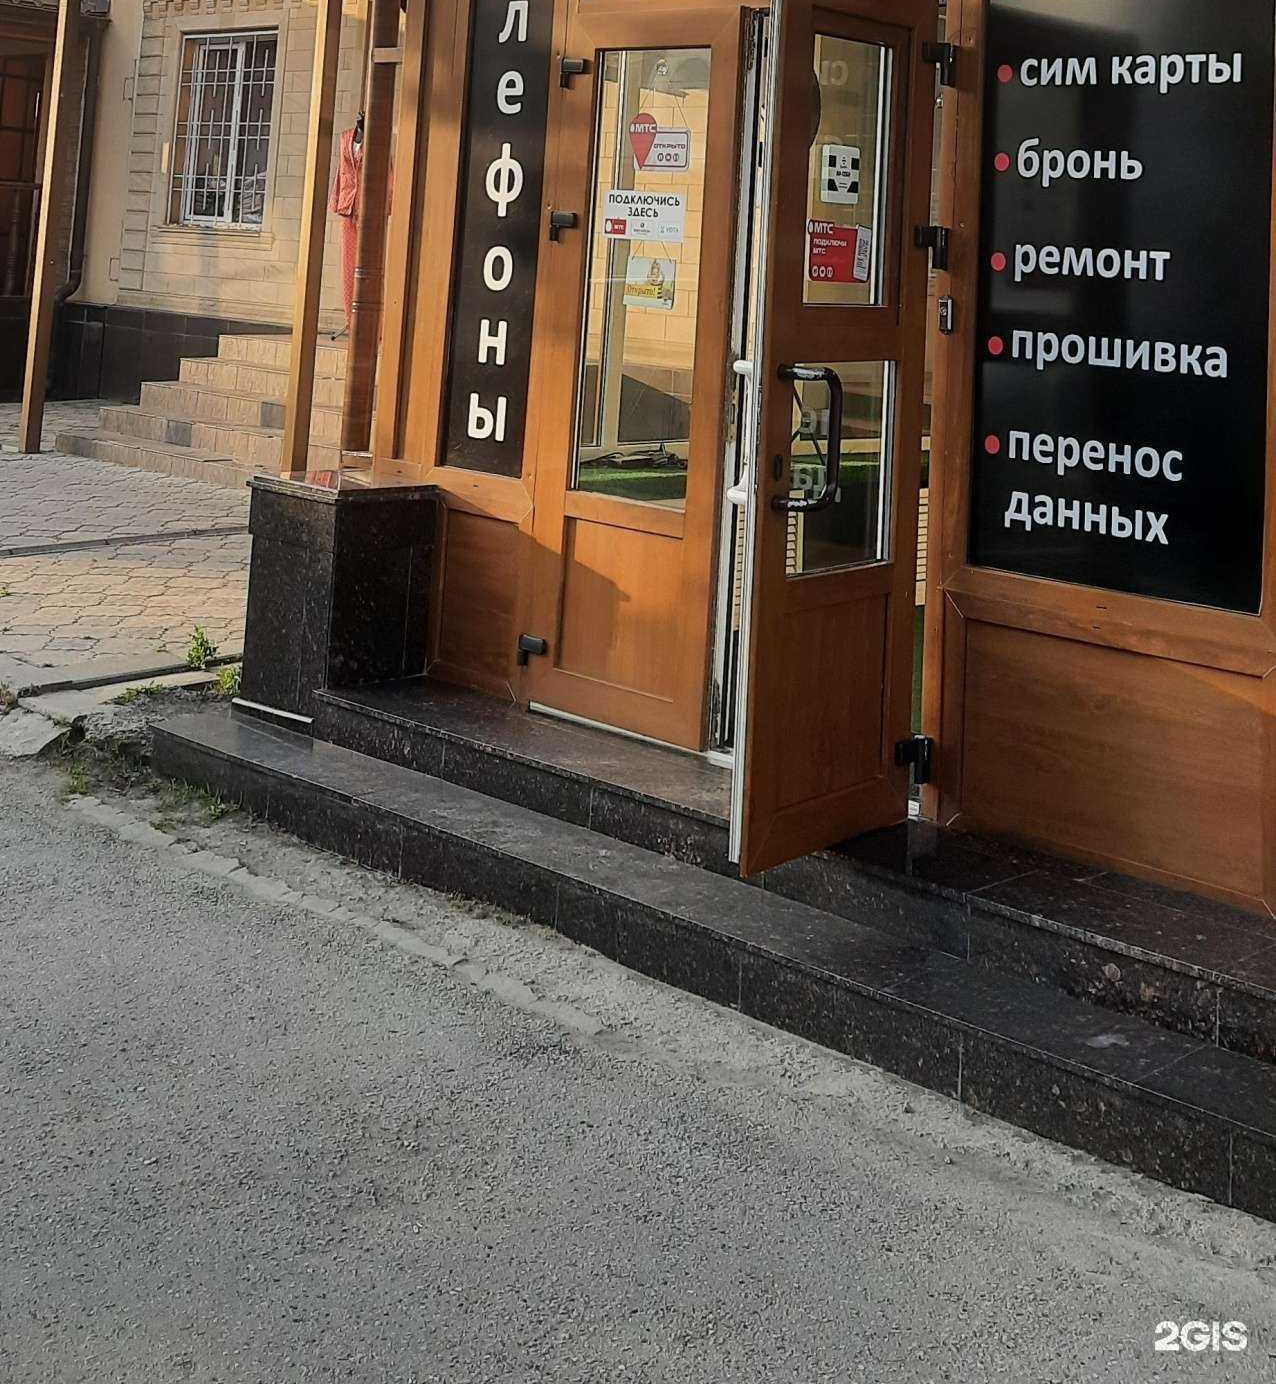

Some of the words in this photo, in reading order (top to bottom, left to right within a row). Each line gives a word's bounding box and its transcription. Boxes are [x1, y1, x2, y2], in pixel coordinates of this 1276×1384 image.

[1018, 54, 1098, 87] сим
[1110, 52, 1243, 95] карты
[1016, 137, 1144, 188] бронь
[608, 193, 681, 207] ПОДКЛЮЧИСЬ
[628, 206, 659, 218] ЗДЕСЬ
[814, 221, 834, 234] МТС
[1013, 243, 1172, 283] ремонт
[1011, 328, 1229, 379] прошивка
[1007, 429, 1184, 483] перенос
[1003, 489, 1170, 546] данных
